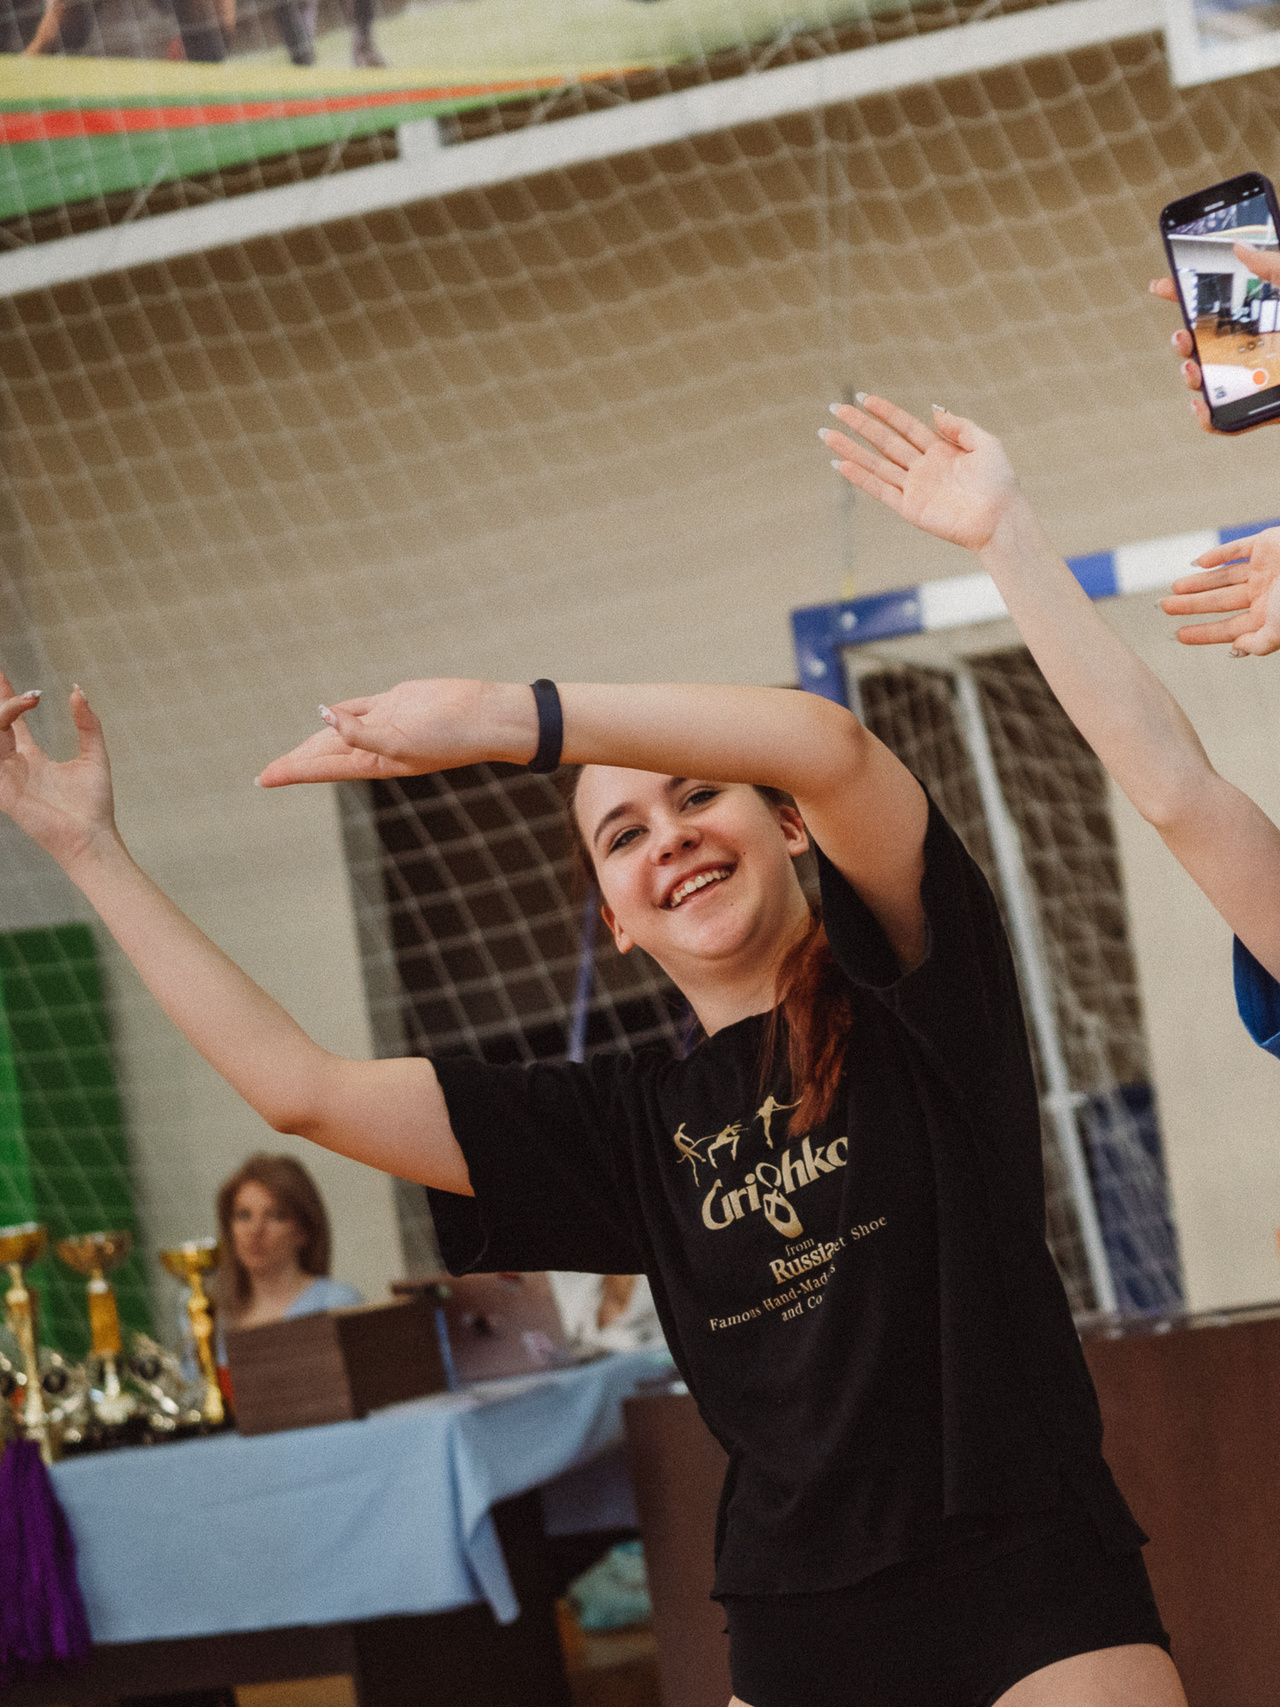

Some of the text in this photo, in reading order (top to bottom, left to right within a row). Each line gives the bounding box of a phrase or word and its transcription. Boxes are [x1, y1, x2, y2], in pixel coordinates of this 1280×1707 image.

[785, 1238, 815, 1256] from
[709, 1307, 762, 1331] Famous
[762, 1271, 831, 1311] Hand-Mad
[850, 1216, 888, 1240] Shoe
[781, 1302, 805, 1321] and
